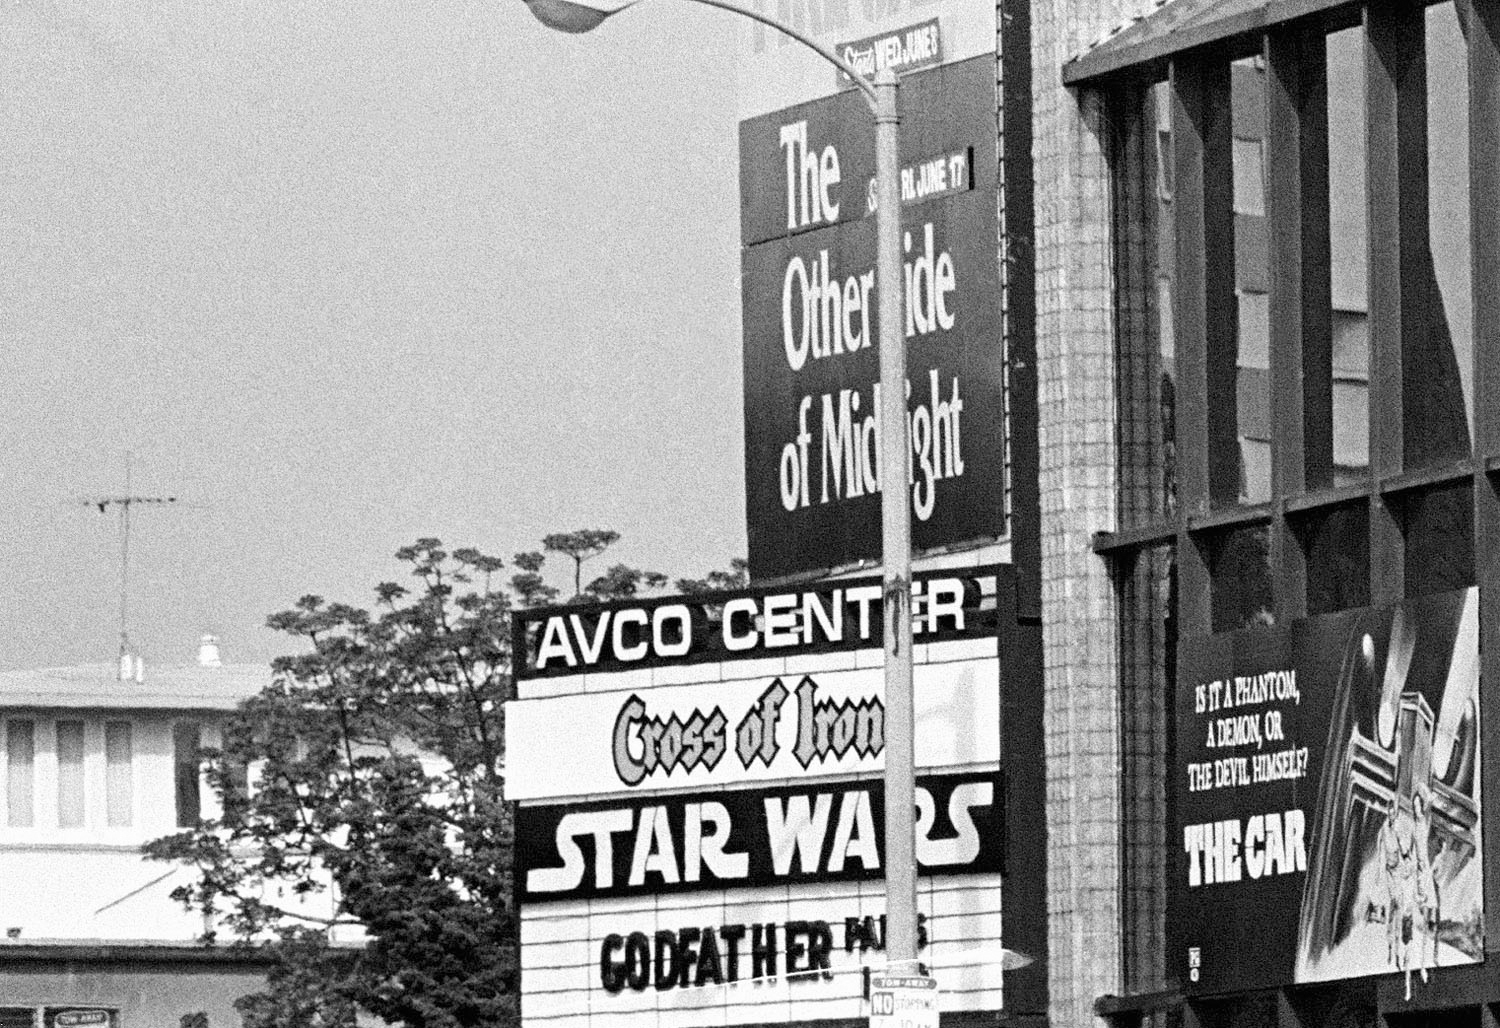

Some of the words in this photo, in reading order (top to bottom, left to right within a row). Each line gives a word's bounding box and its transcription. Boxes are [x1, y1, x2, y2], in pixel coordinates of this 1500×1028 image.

[780, 121, 840, 229] The
[917, 158, 947, 197] JUNE
[782, 249, 874, 371] Other
[904, 222, 956, 337] ide
[780, 396, 811, 511] of
[821, 369, 964, 521] Midight
[536, 605, 691, 668] AVCO
[1196, 686, 1205, 713] IS
[1208, 680, 1221, 712] IT
[1223, 681, 1233, 706] A
[1235, 670, 1300, 705] PHANTOM,
[612, 694, 728, 786] Cross
[736, 678, 790, 769] of
[793, 676, 886, 769] Iron
[1206, 722, 1215, 747] A
[1217, 714, 1262, 748] DEMON,
[1264, 711, 1283, 741] OR
[1188, 762, 1213, 791] THE
[1216, 755, 1250, 789] DEVIL
[1253, 747, 1308, 784] HIMSELF?
[527, 801, 749, 892] STAR
[1184, 819, 1242, 886] THE
[1245, 809, 1307, 879] CAR
[600, 919, 833, 994] GODFATHER
[872, 994, 893, 1014] NO
